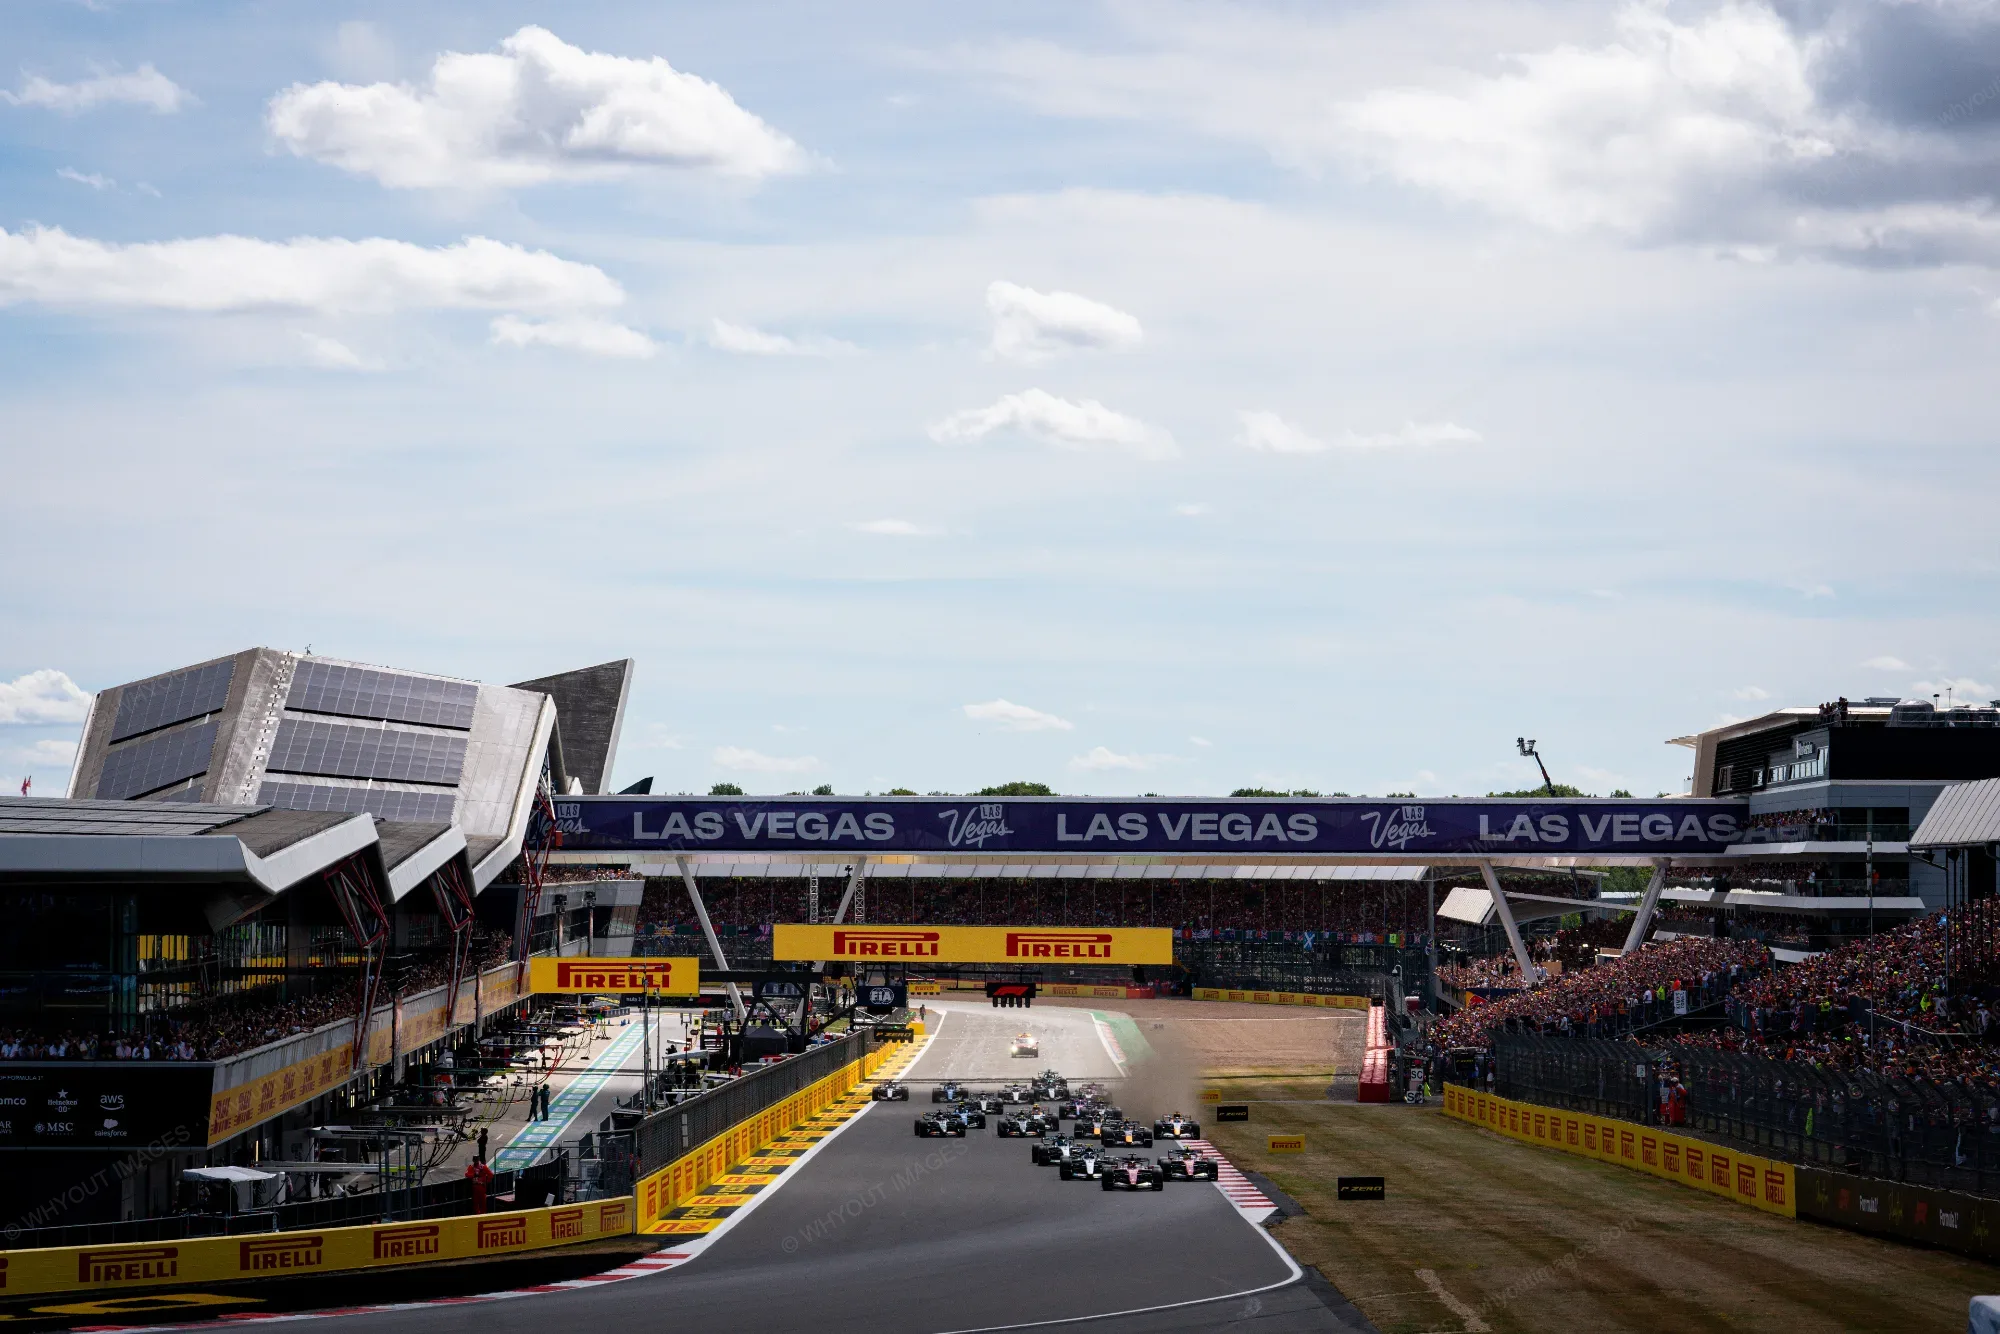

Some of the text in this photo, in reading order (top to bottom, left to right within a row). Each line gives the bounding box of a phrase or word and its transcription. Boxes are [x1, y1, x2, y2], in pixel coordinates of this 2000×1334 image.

[560, 805, 578, 816] LAS
[982, 806, 1001, 818] LAS
[1404, 807, 1423, 820] LAS
[634, 811, 895, 841] LAS VEGAS
[939, 806, 1014, 848] Vegas
[1057, 812, 1319, 842] LAS VEGAS
[1360, 807, 1437, 850] Vegas
[1479, 813, 1744, 843] LAS VEGAS
[834, 931, 940, 956] PIRELLI
[1006, 932, 1113, 958] PIRELLI
[557, 962, 672, 988] PIRELLI
[870, 990, 893, 1002] FIA
[1411, 1070, 1423, 1079] SC
[100, 1094, 124, 1104] aws
[47, 1122, 74, 1132] MSC
[94, 1129, 128, 1137] salesforce
[1272, 1141, 1301, 1149] PIRELLI
[1686, 1147, 1704, 1180] PIRELLI
[1711, 1154, 1730, 1188] PIRELLI
[1737, 1162, 1757, 1198] PIRELLI
[1765, 1169, 1786, 1205] PIRELLI
[477, 1217, 527, 1249] PIRELLI
[551, 1208, 583, 1240] PIRELLI
[600, 1203, 625, 1233] PIRELLI
[239, 1235, 324, 1271] PIRELLI
[373, 1225, 439, 1260] PIRELLI
[78, 1247, 179, 1283] PIRELLI
